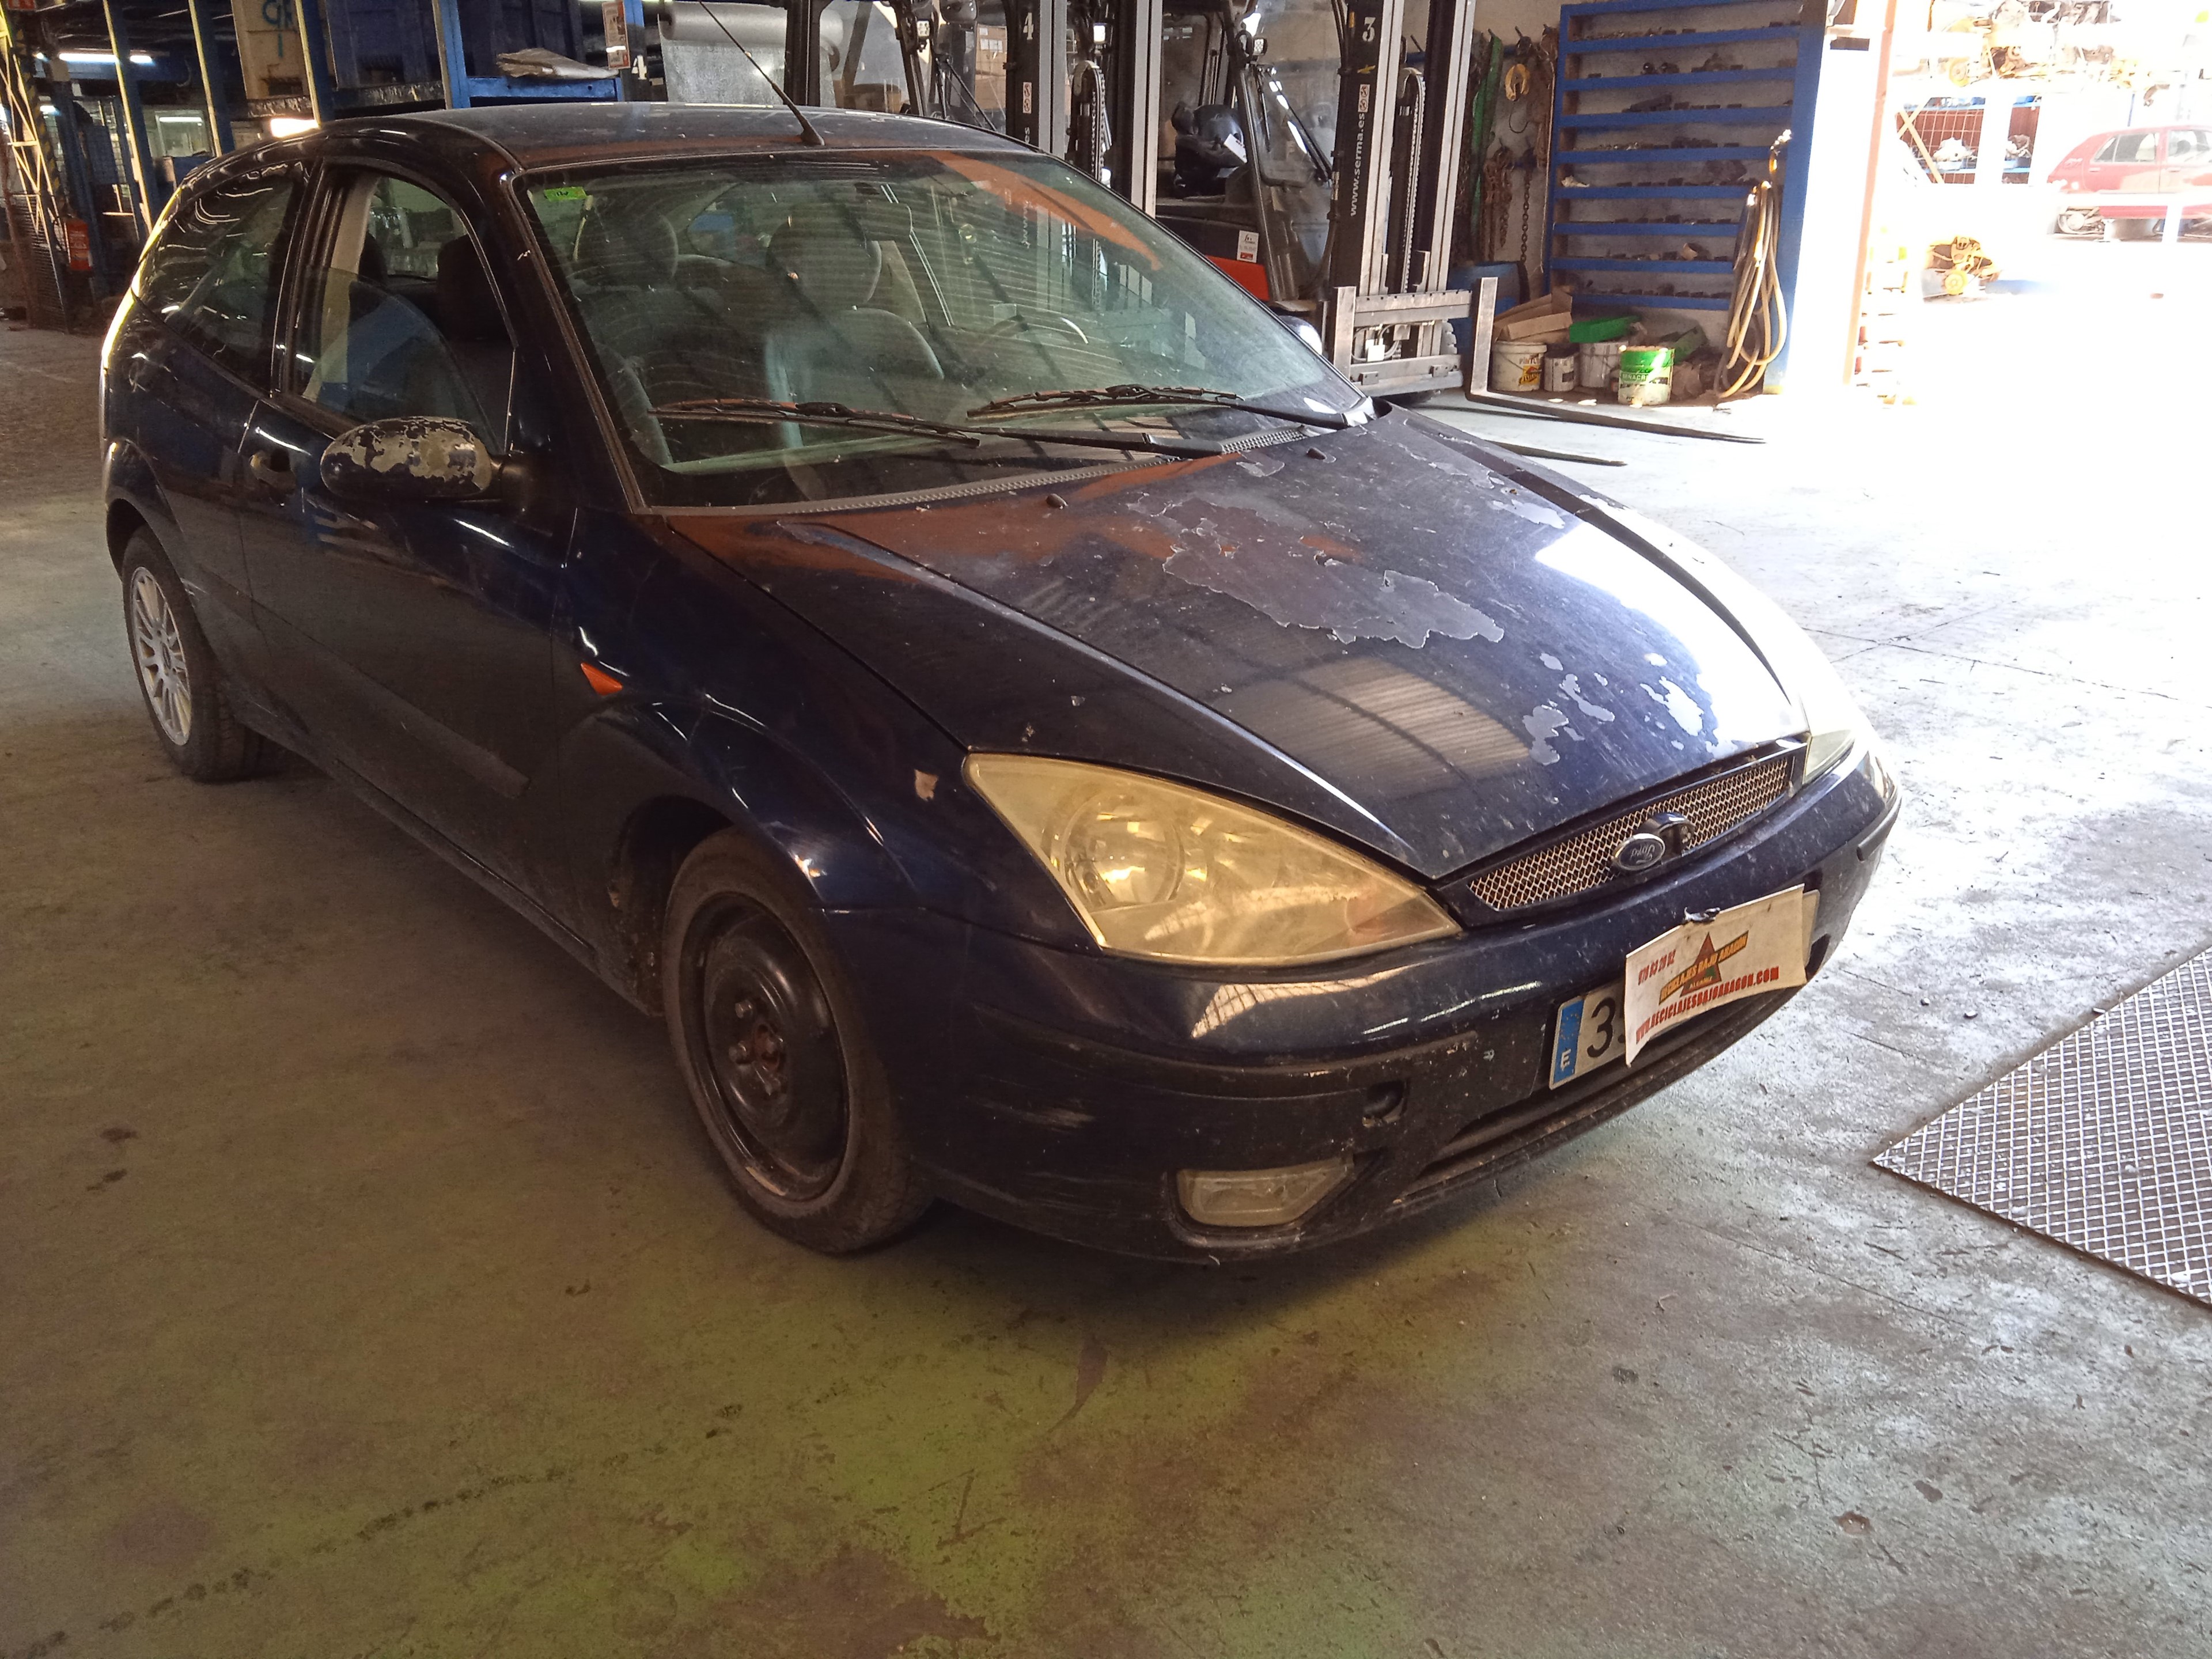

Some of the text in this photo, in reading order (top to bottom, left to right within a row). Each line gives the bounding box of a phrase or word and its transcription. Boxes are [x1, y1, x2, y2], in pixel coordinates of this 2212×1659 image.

[1023, 12, 1034, 40] 4
[1362, 17, 1376, 42] 3
[631, 54, 647, 79] 4
[1350, 113, 1365, 217] www.serma.es
[1629, 843, 1656, 864] Ford
[1698, 952, 1718, 974] BAJO
[1587, 997, 1626, 1058] 3
[1560, 1048, 1571, 1072] E
